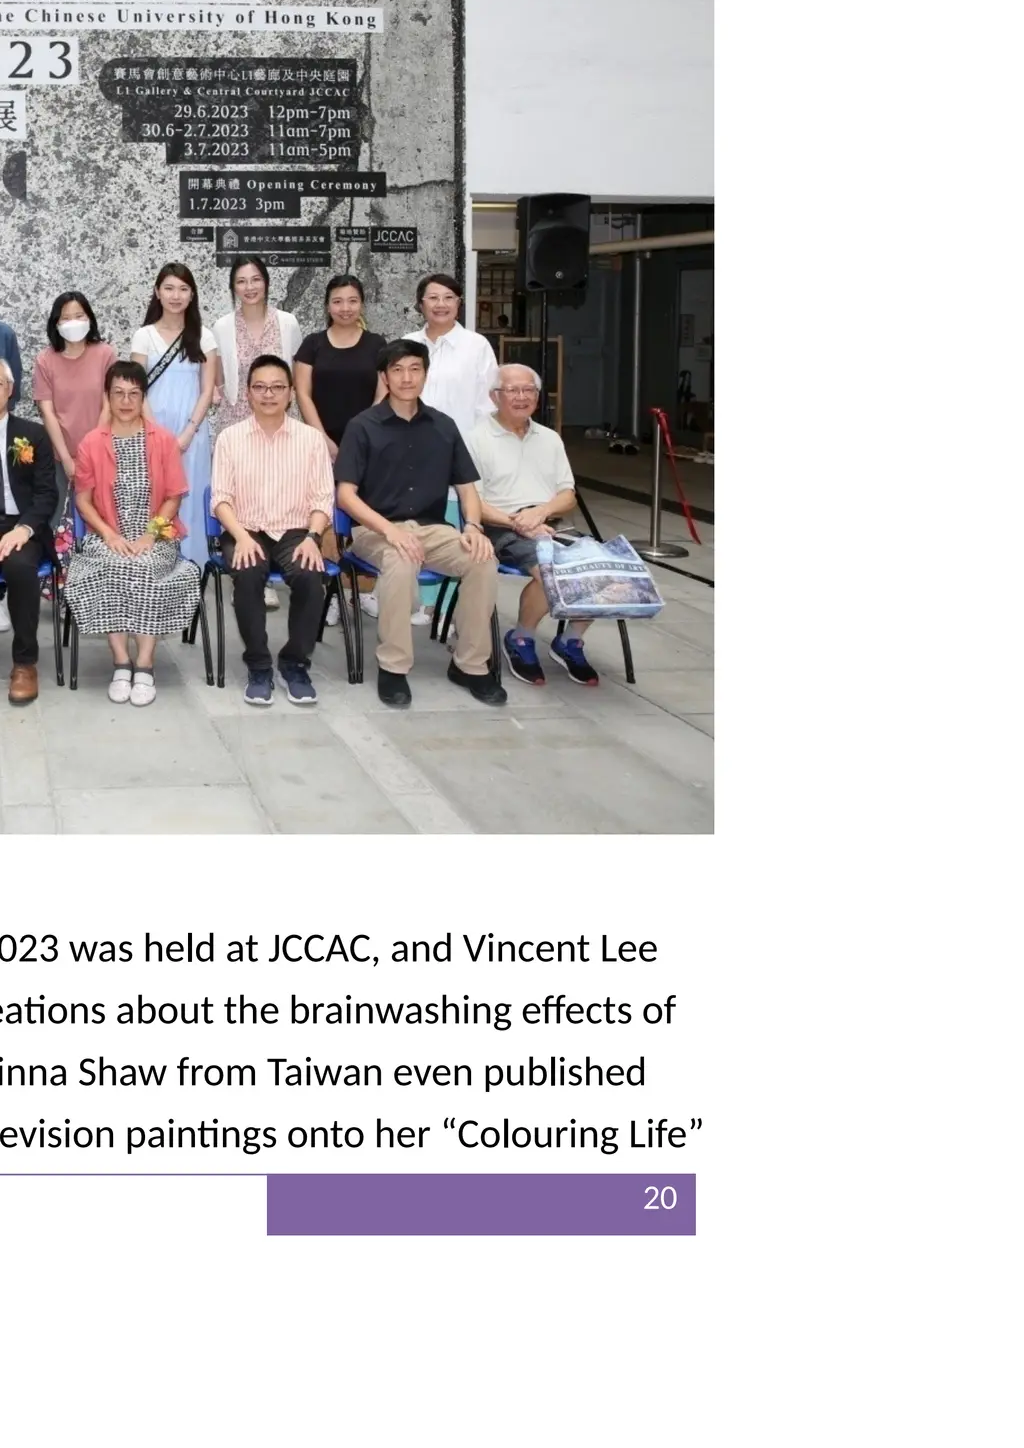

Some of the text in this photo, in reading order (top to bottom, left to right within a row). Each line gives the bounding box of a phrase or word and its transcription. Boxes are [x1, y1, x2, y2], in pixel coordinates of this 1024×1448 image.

[24, 8, 107, 23] Chinese
[117, 9, 226, 28] University
[235, 9, 256, 24] of
[264, 10, 317, 28] Hong
[326, 11, 377, 29] Kong
[135, 86, 178, 97] Gallery
[183, 86, 192, 96] &
[197, 86, 241, 97] Central
[245, 87, 305, 98] Courtyard
[309, 87, 351, 97] JCCAC
[174, 105, 351, 122] 29.6.2023 12pm-7pm
[142, 123, 351, 140] 30.6-2.7.2023 11am-7pm
[184, 142, 351, 159] 3.7.2023 11am-5pm
[187, 177, 378, 192] 開幕典禮 Opening Ceremony
[189, 197, 286, 212] 1.7.2023 3pm
[374, 230, 414, 242] JCCAC
[68, 940, 133, 963] was
[145, 932, 214, 963] held
[226, 934, 259, 963] at
[268, 934, 379, 968] JCCAC,
[391, 932, 452, 963] and
[462, 932, 590, 963] Vincent
[602, 934, 658, 963] Lee
[116, 994, 214, 1025] about
[223, 994, 279, 1025] the
[291, 994, 512, 1031] brainwashing
[522, 994, 632, 1025] effects
[642, 994, 677, 1025] of
[78, 1056, 168, 1087] Shaw
[176, 1056, 256, 1087] from
[266, 1056, 382, 1087] Taiwan
[393, 1064, 472, 1087] even
[485, 1056, 645, 1093] published
[127, 1118, 277, 1155] paintings
[287, 1120, 365, 1149] onto
[376, 1118, 431, 1149] her
[443, 1117, 619, 1155] “Colouring
[630, 1117, 703, 1149] Life”
[644, 1186, 677, 1209] 20
